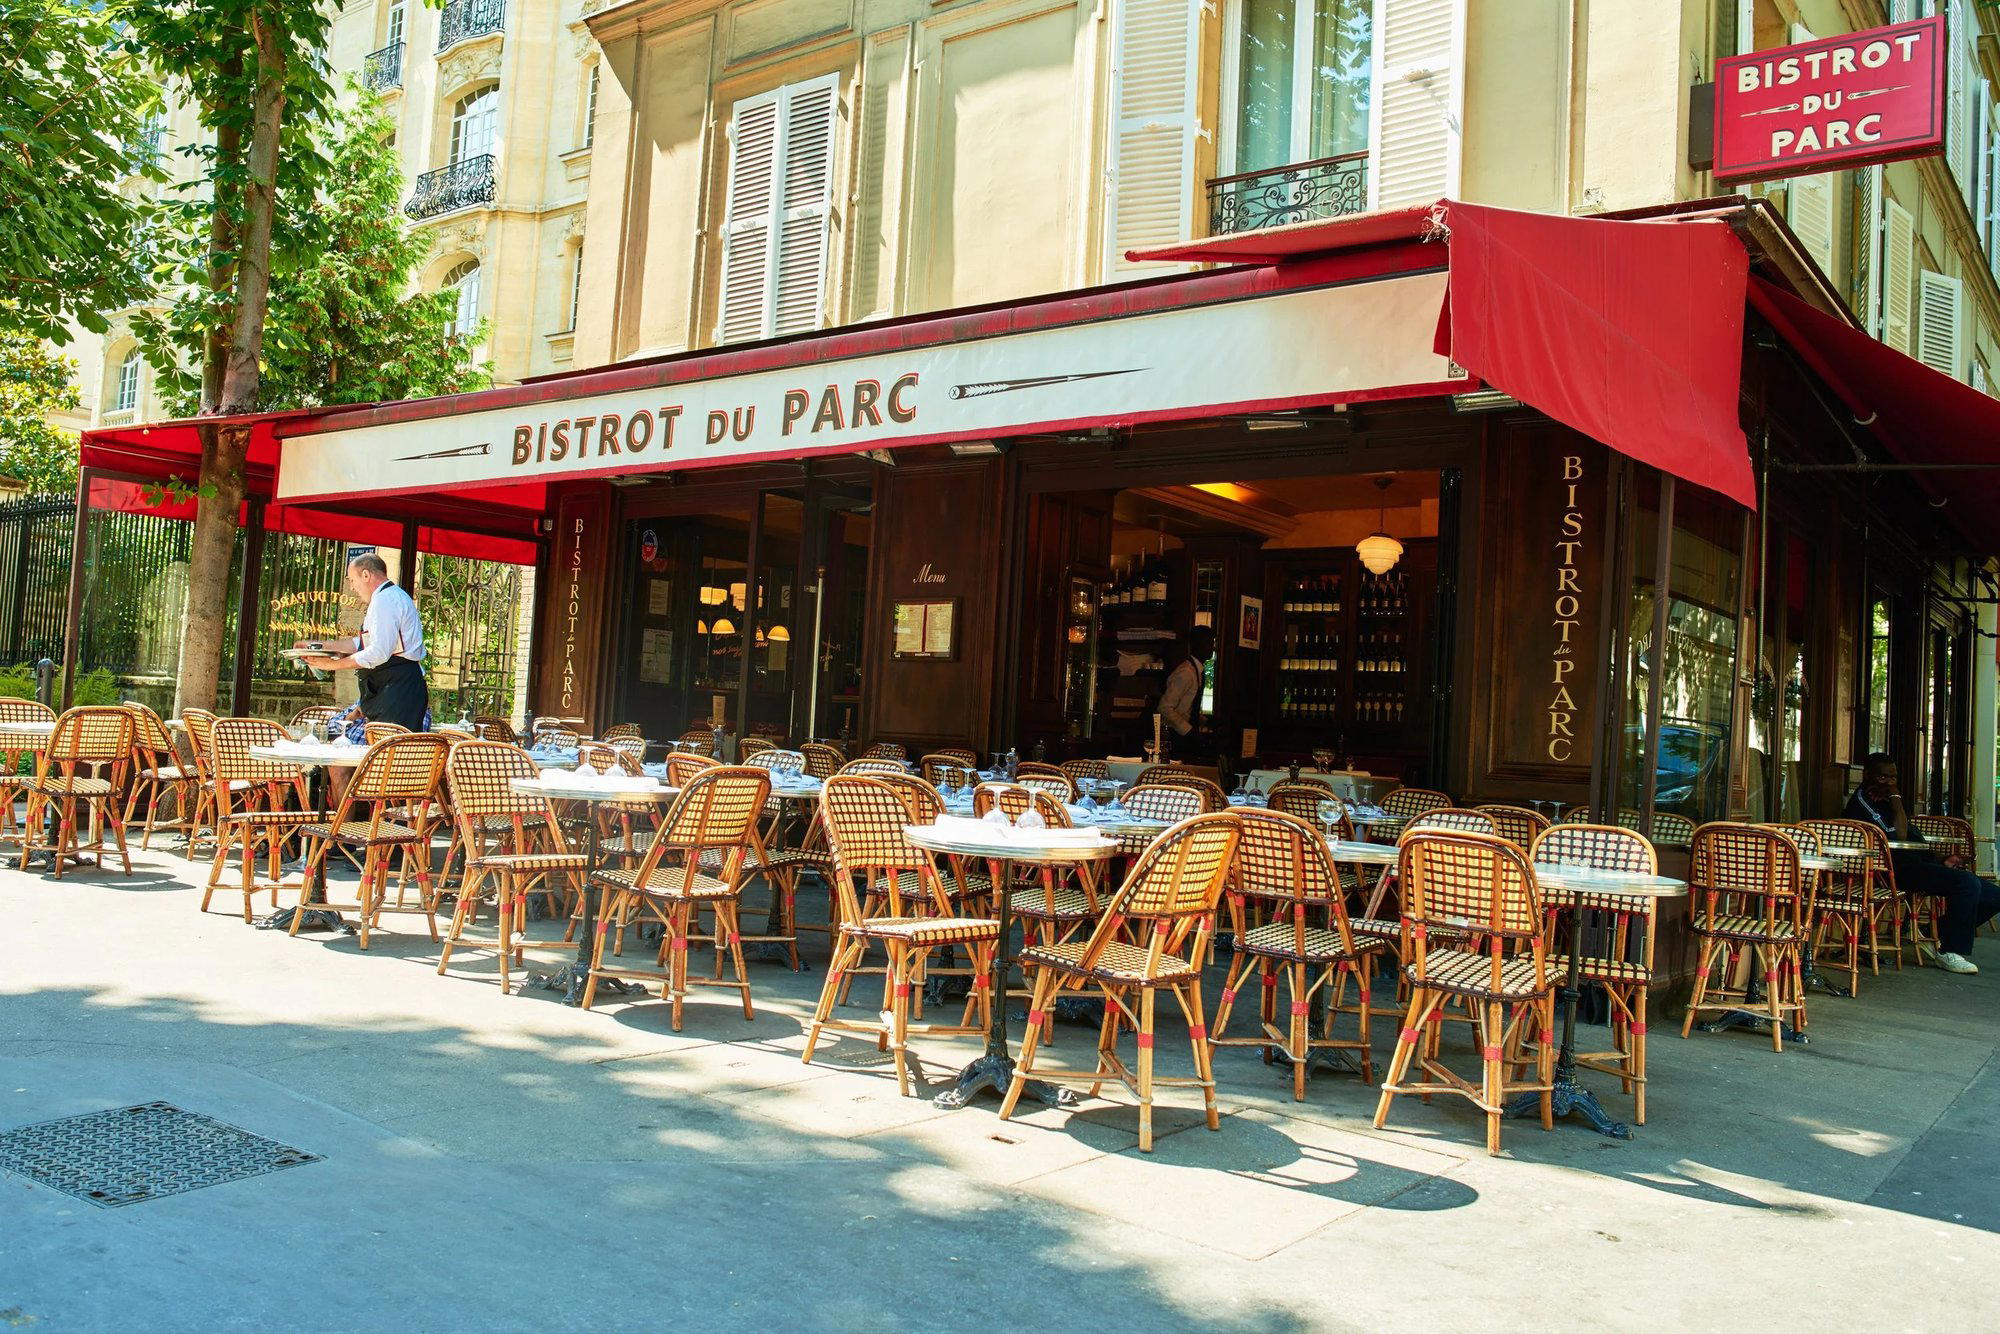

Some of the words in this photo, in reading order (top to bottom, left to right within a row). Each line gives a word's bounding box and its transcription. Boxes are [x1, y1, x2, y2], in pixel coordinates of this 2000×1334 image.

[1738, 32, 1921, 93] BISTROT
[1802, 90, 1842, 115] DU
[1771, 113, 1882, 158] PARC
[511, 405, 683, 466] BISTROT
[705, 405, 755, 445] DU
[781, 373, 919, 437] PARC
[568, 518, 584, 633] BISTROT
[912, 563, 947, 583] Menu
[1552, 456, 1584, 642] BISTROT
[562, 644, 575, 708] PARC
[1553, 644, 1572, 656] du
[1548, 659, 1578, 761] PARC
